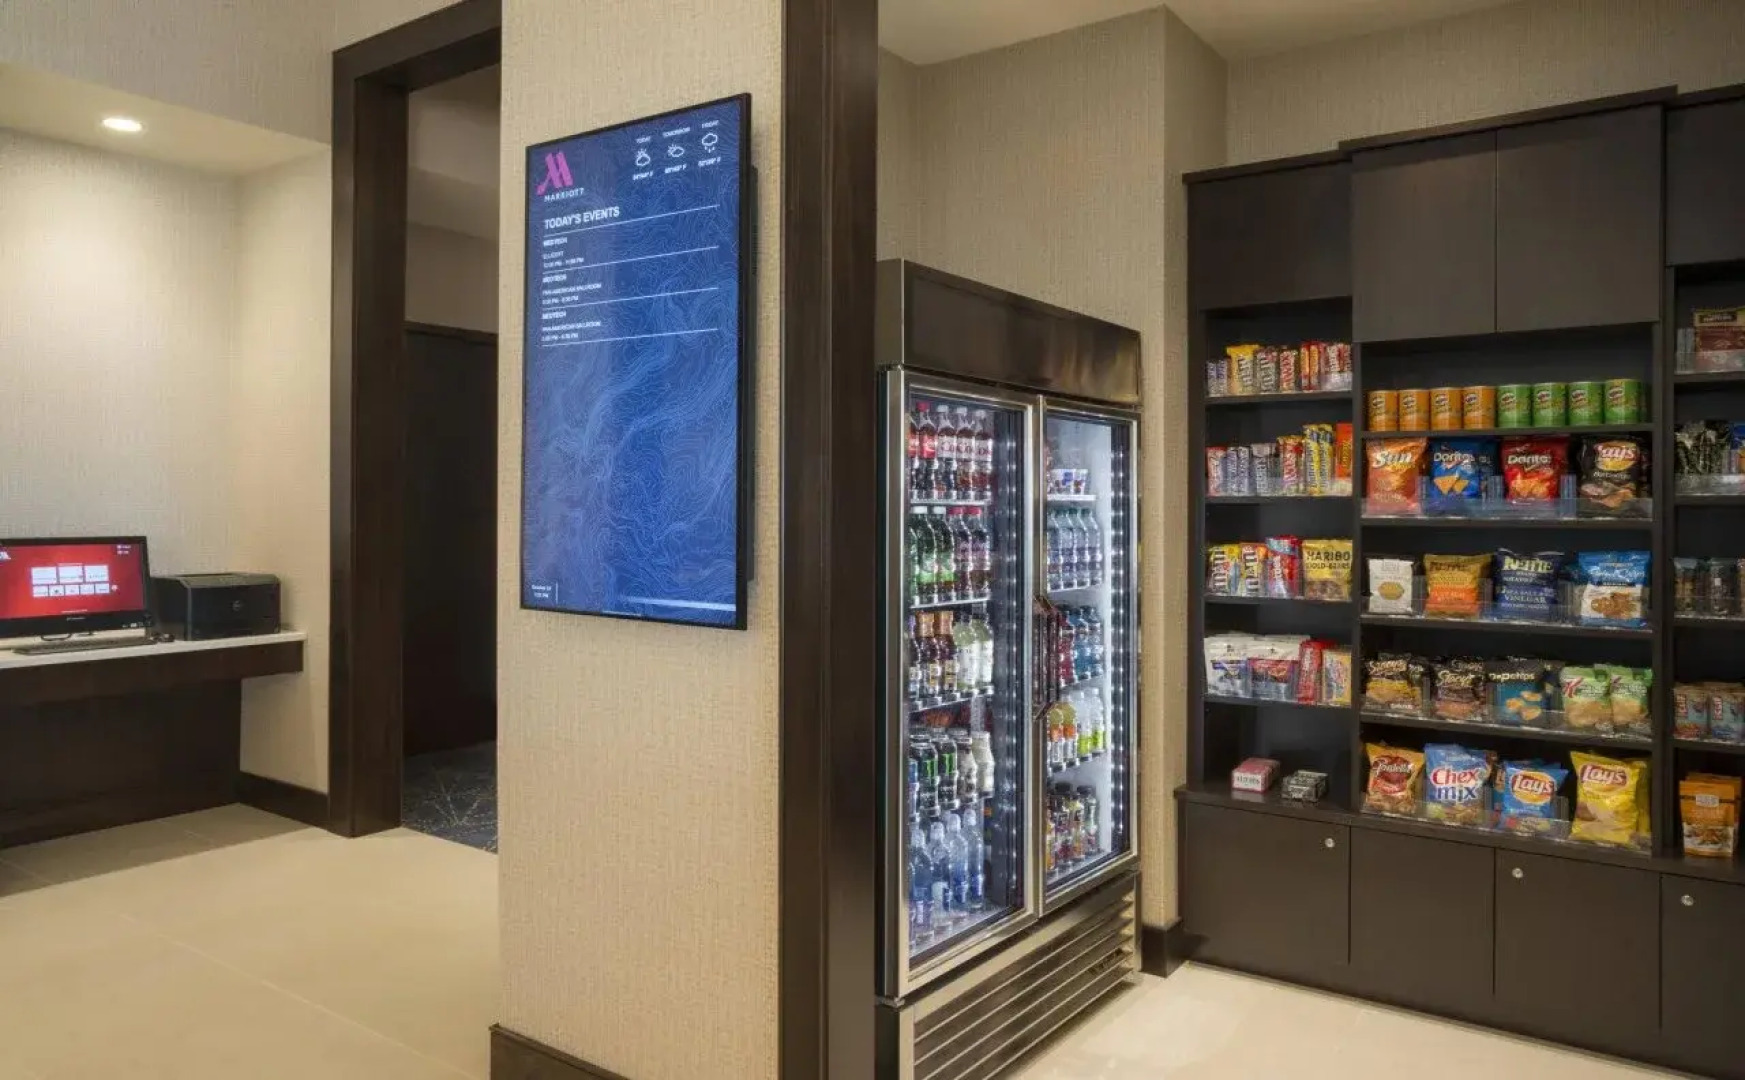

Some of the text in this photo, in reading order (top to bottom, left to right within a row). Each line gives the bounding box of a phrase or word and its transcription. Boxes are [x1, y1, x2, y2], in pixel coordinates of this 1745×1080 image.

[544, 187, 584, 202] MARRIOTT
[545, 206, 620, 229] TODAY'S EVENTS
[1372, 450, 1412, 468] Sun
[1307, 551, 1350, 561] HARIBO
[1504, 595, 1547, 604] VINEGAR
[1431, 767, 1476, 785] Chex
[1437, 786, 1476, 803] mix
